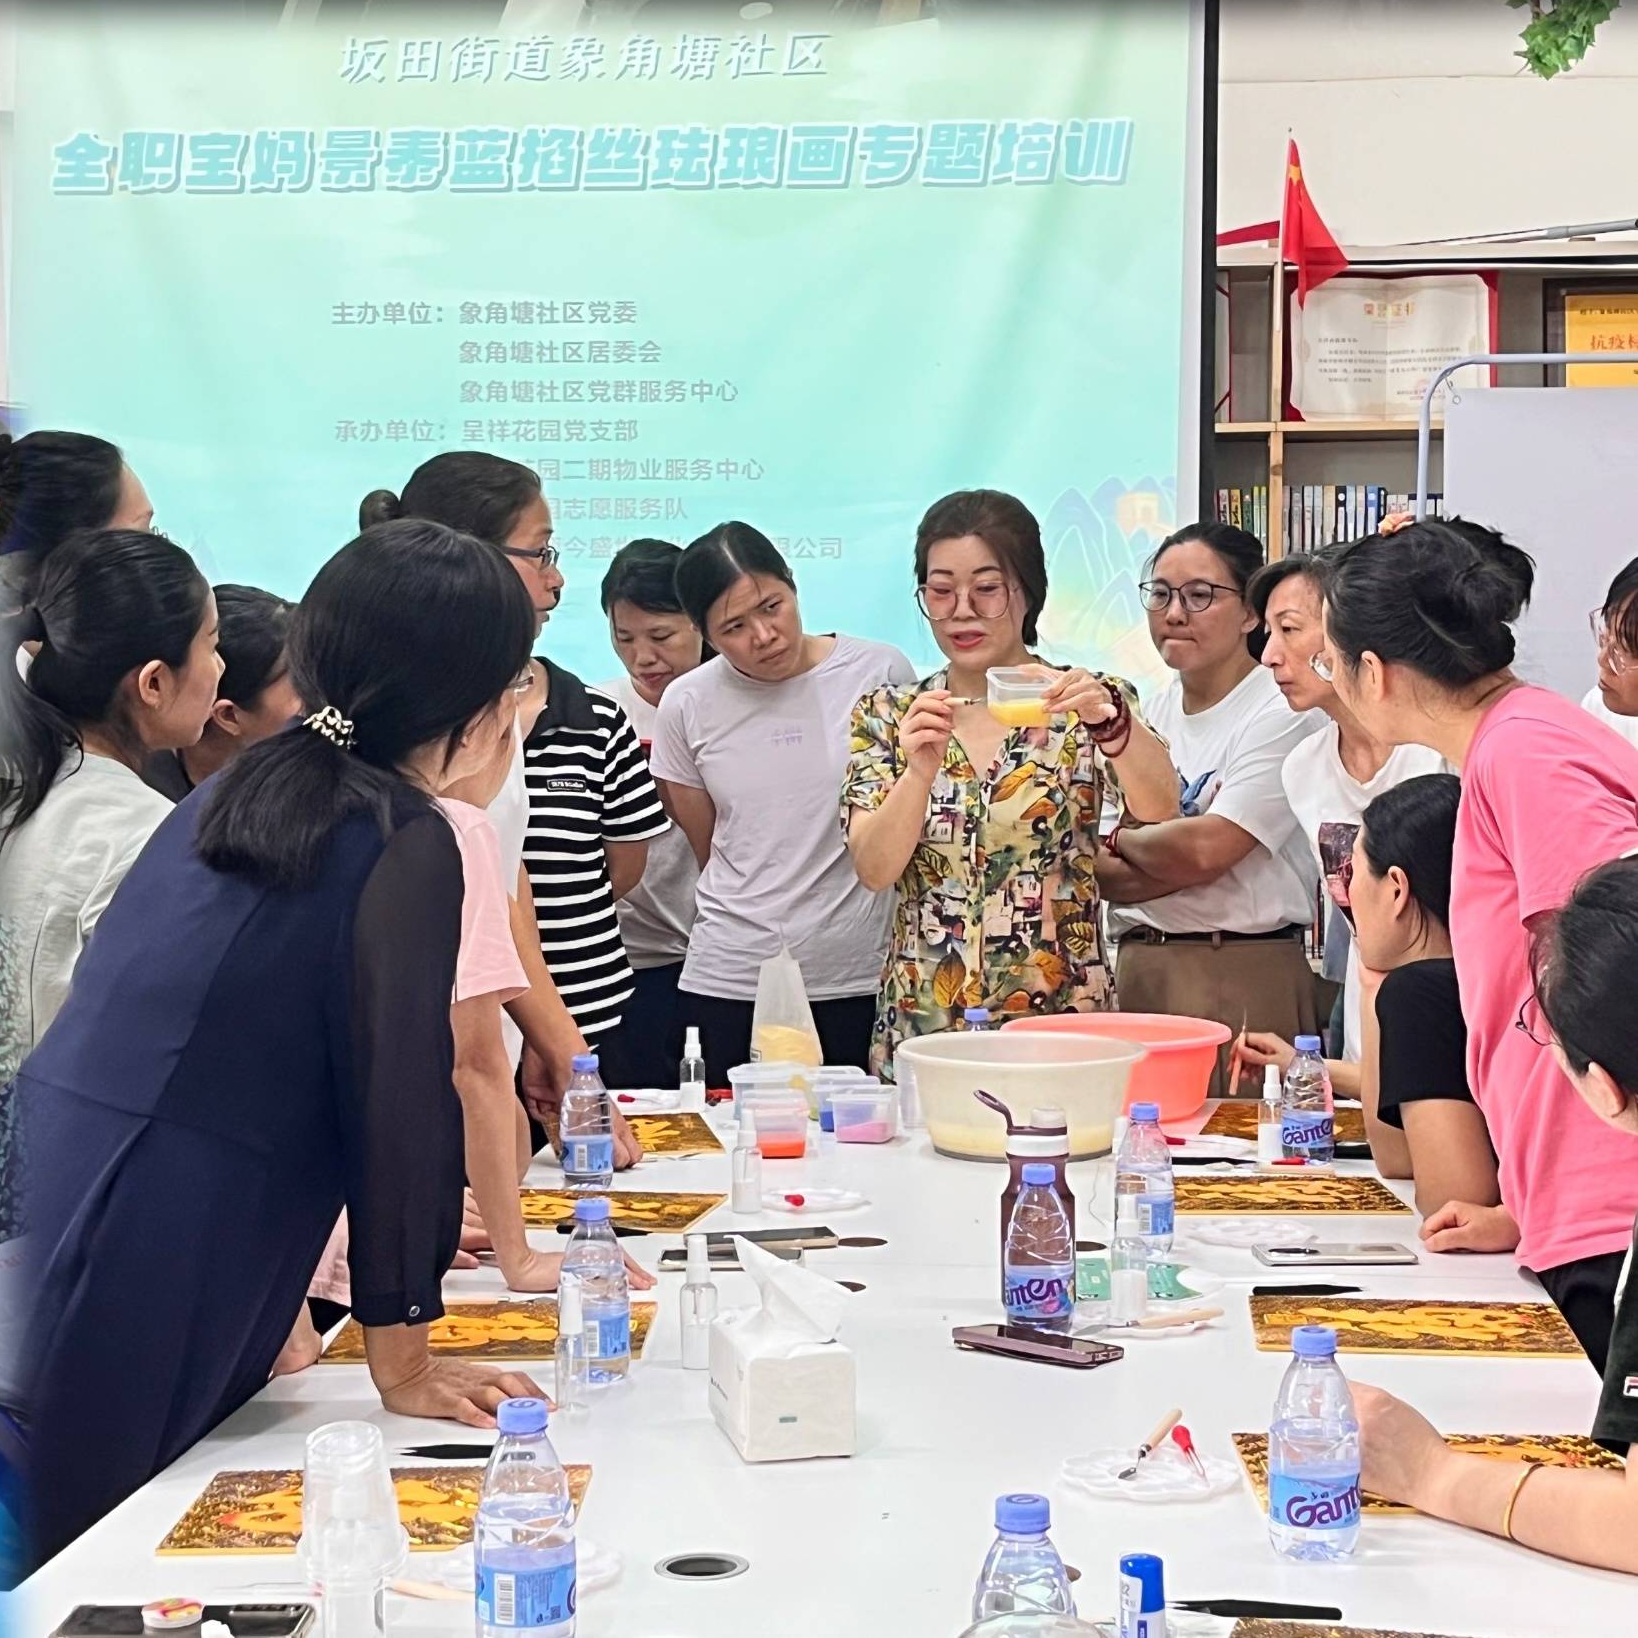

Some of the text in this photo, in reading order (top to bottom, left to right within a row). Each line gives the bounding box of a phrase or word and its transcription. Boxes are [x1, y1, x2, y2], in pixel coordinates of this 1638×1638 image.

[340, 33, 833, 84] 坂田街道象角塘社区
[52, 117, 1134, 196] 全职宝妈景泰蓝掐丝珐琅画专题培训
[458, 340, 662, 364] 象角塘社区居委会
[459, 380, 739, 403] 象角塘社区党群服务中心
[520, 458, 764, 481] 园二期物业服务中心
